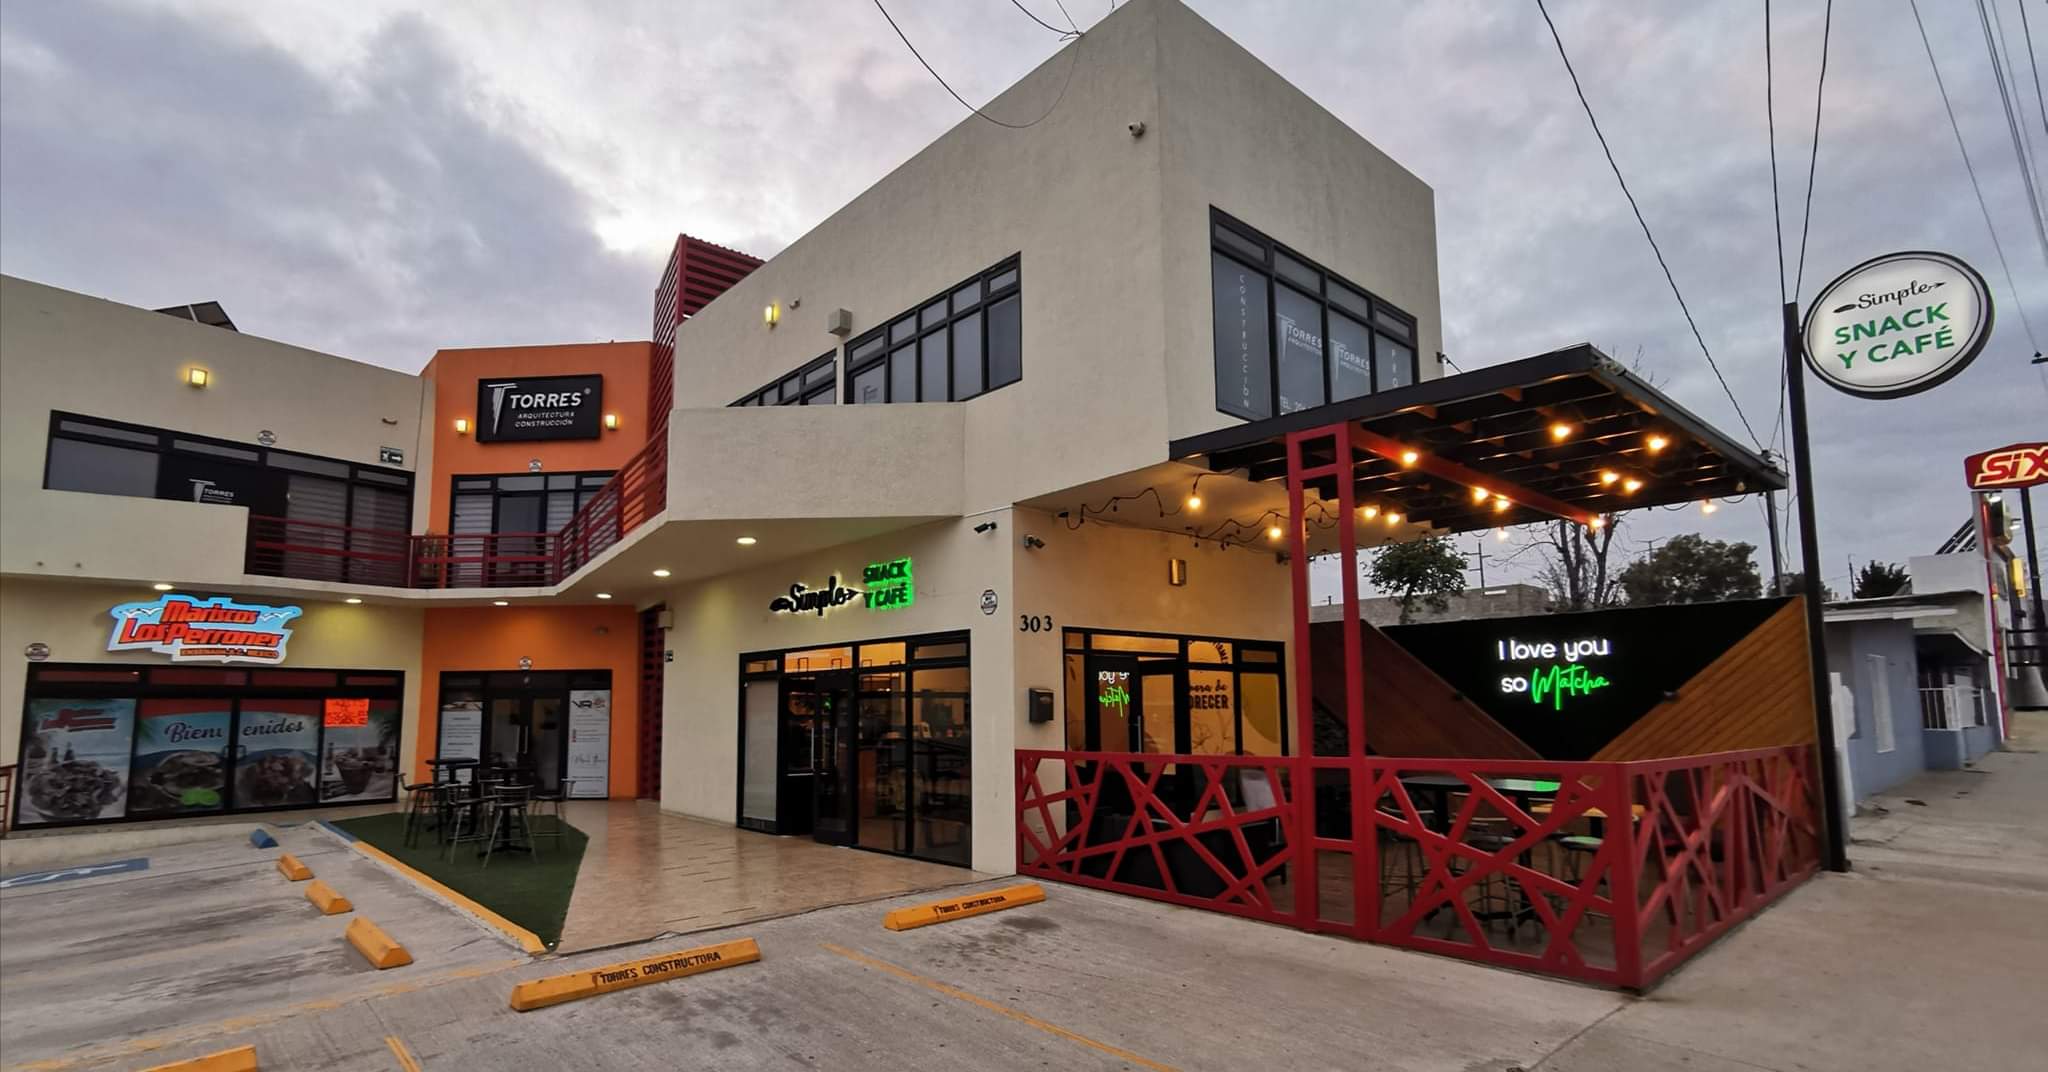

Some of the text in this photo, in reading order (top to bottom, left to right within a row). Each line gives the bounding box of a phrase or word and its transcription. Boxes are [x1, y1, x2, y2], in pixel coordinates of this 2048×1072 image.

[1858, 280, 1932, 310] Simple
[1835, 302, 1950, 345] SNACK
[1837, 326, 1955, 369] Y CAFÉ
[510, 392, 582, 409] TORRES
[514, 418, 574, 428] CONSTRUCCIÓN
[517, 411, 575, 419] ARQUITECTURA
[863, 561, 909, 584] SNACK
[790, 575, 848, 616] Simple
[864, 581, 909, 608] Y CAFÉ
[160, 600, 260, 624] Mariscos
[1019, 614, 1053, 633] 303
[1498, 638, 1610, 663] I love you
[1501, 664, 1610, 710] so Matcha
[600, 951, 722, 985] TORRES CONSTRUCTORA
